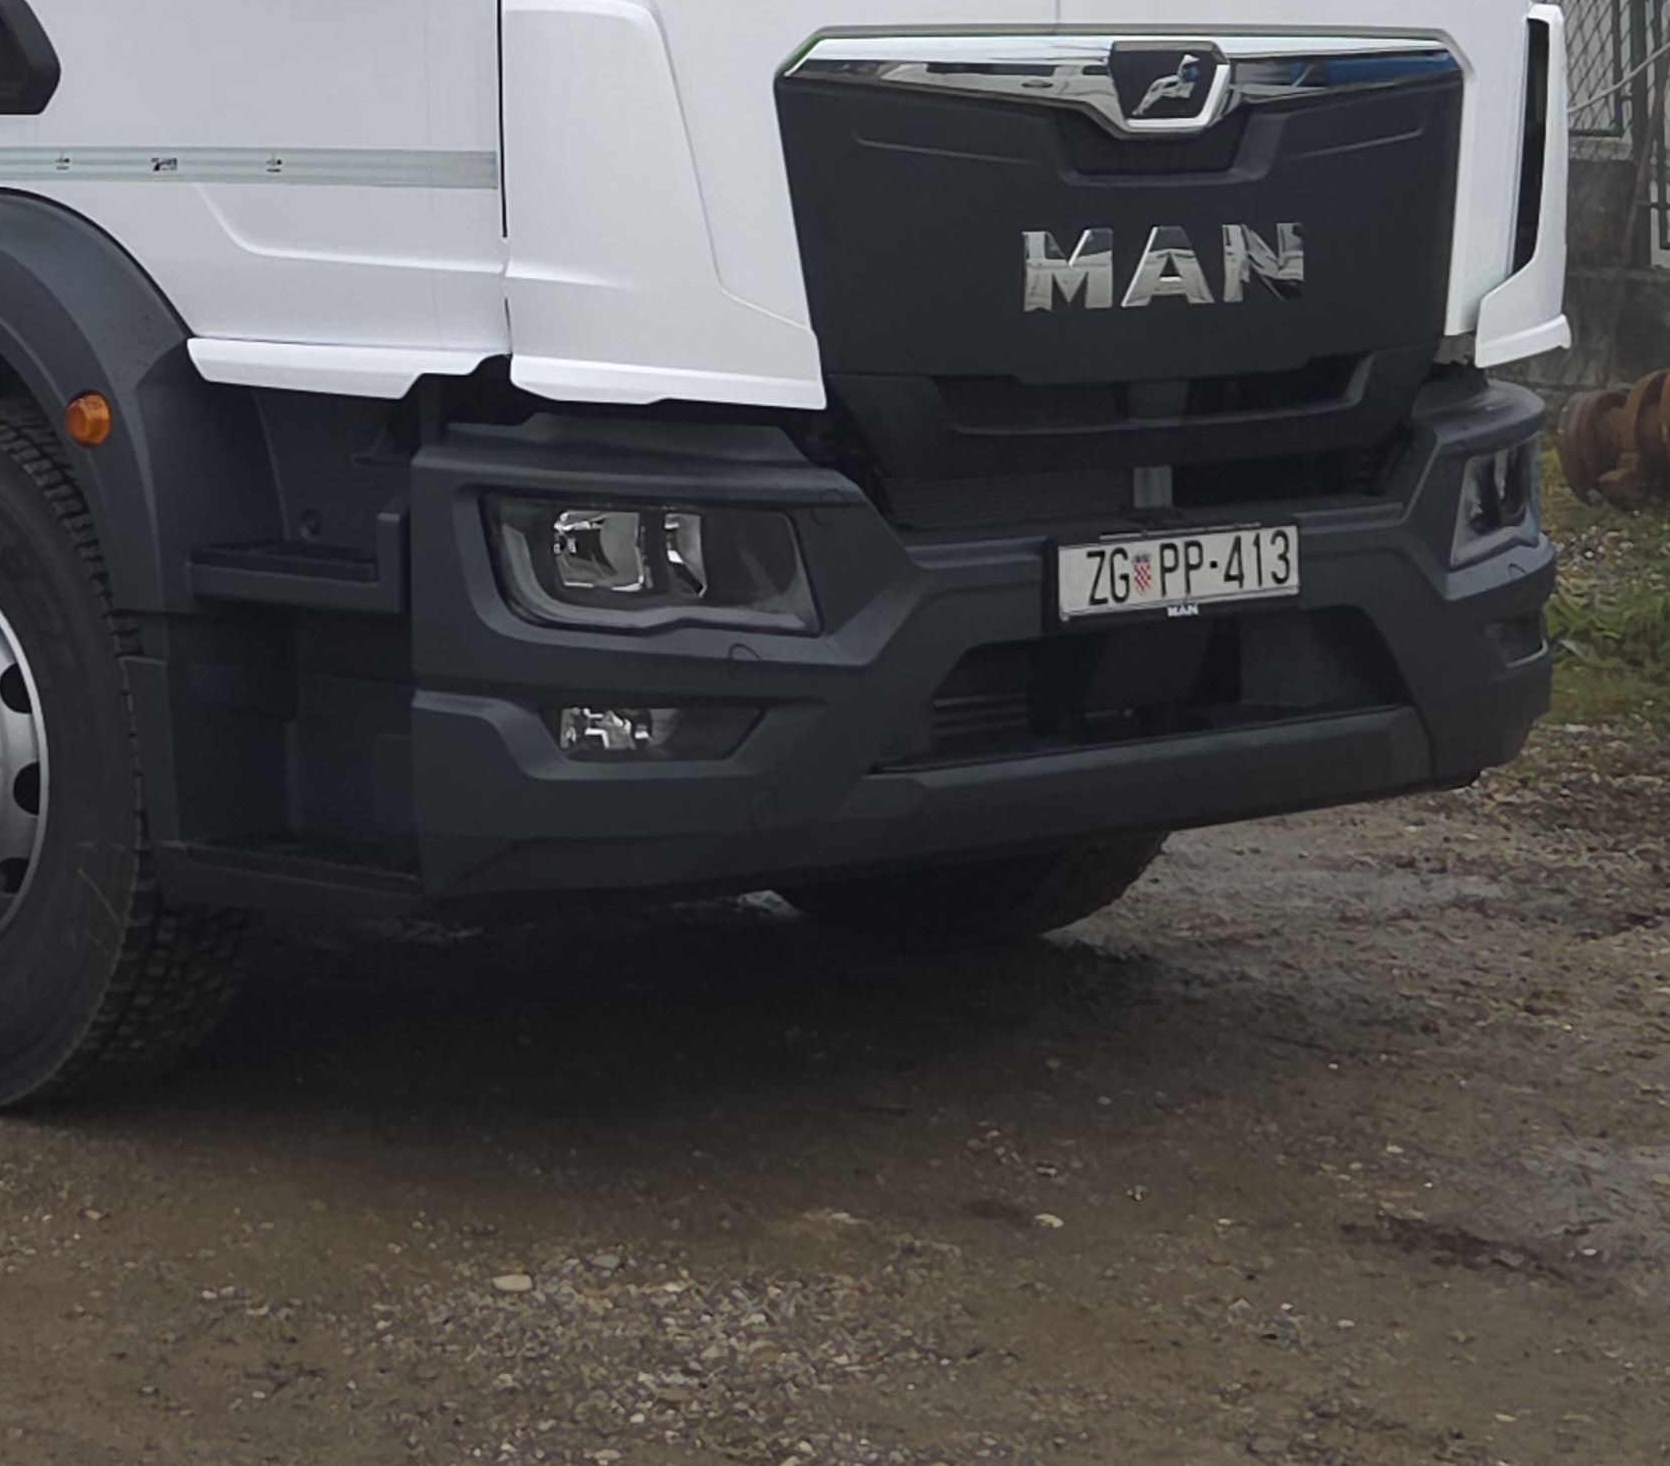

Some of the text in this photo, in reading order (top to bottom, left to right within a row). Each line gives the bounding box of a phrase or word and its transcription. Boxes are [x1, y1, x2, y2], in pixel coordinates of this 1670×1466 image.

[1022, 222, 1304, 312] MAN
[1086, 547, 1130, 606] ZG
[1167, 604, 1198, 617] MAN
